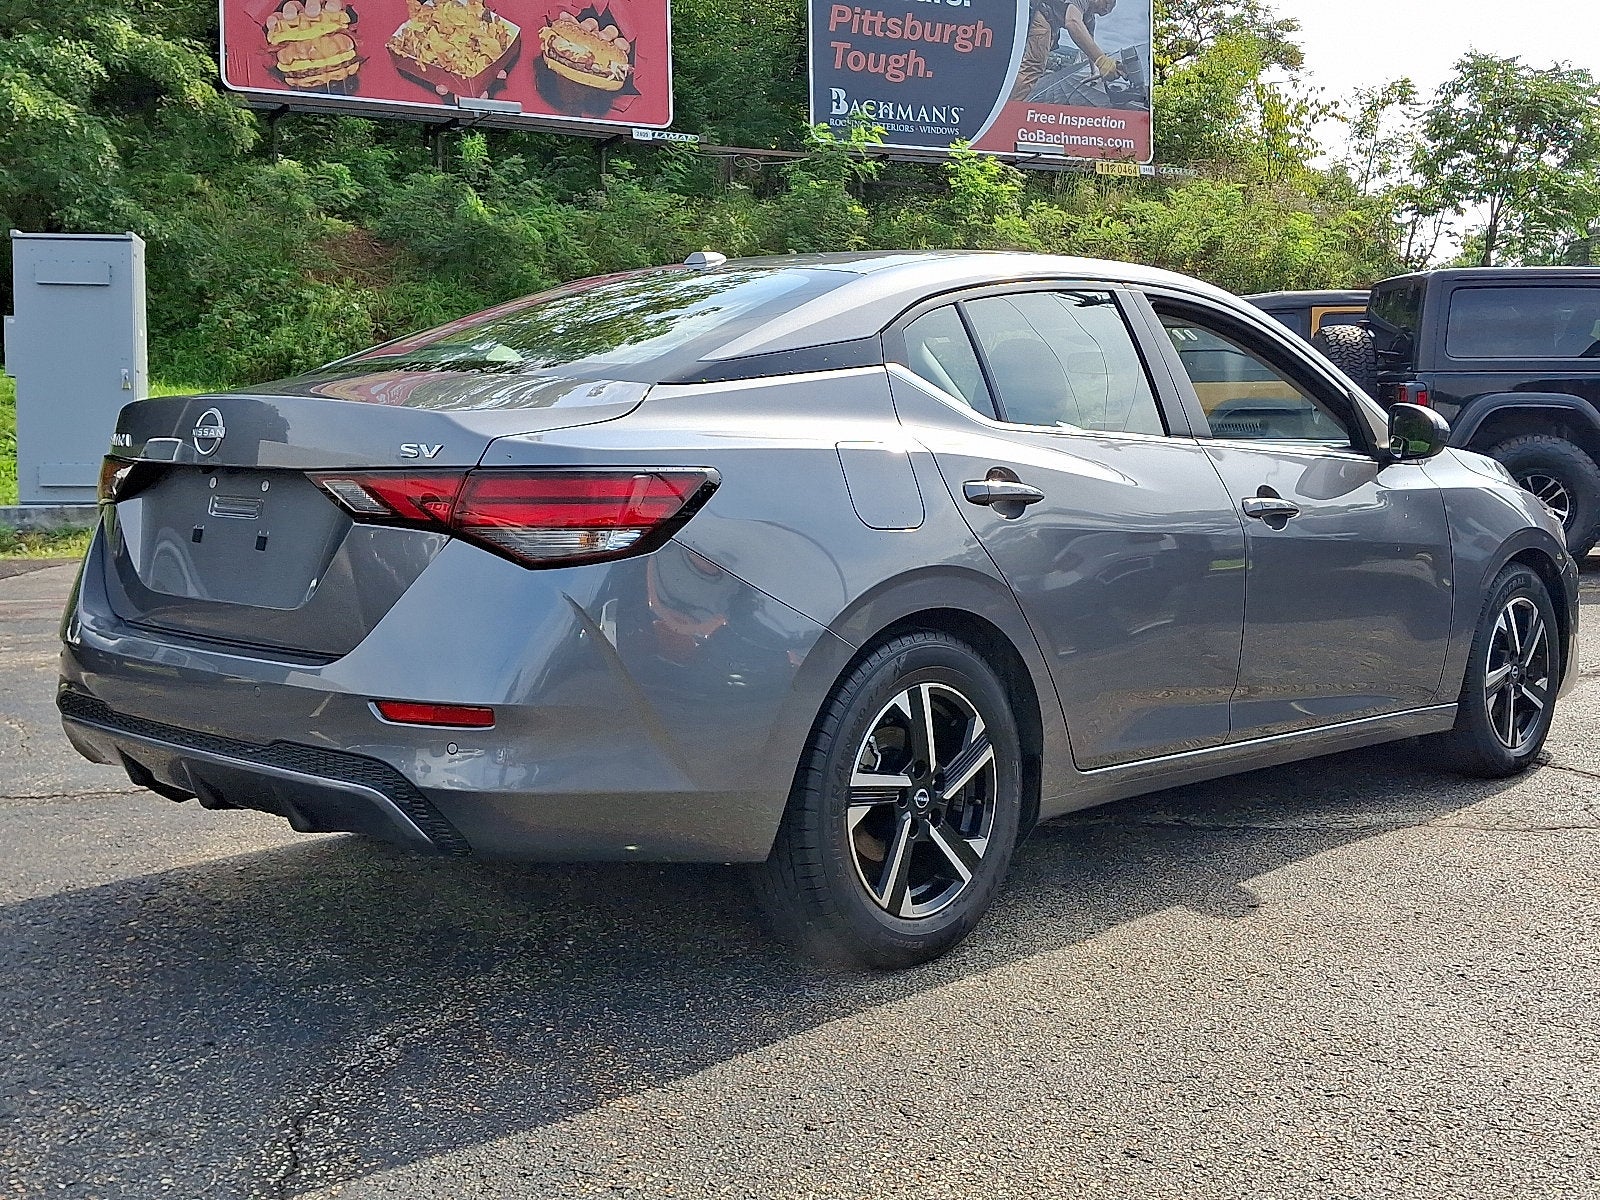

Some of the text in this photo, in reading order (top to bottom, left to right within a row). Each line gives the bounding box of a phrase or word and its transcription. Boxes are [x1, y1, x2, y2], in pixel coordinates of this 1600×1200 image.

[829, 4, 994, 53] Pittsburgh
[830, 41, 934, 83] Tough.
[1026, 109, 1126, 129] Free Inspection
[919, 125, 960, 136] WINDOWS
[1017, 128, 1135, 149] GoBachmans.com
[192, 426, 225, 438] NISSAN
[400, 443, 444, 459] SV
